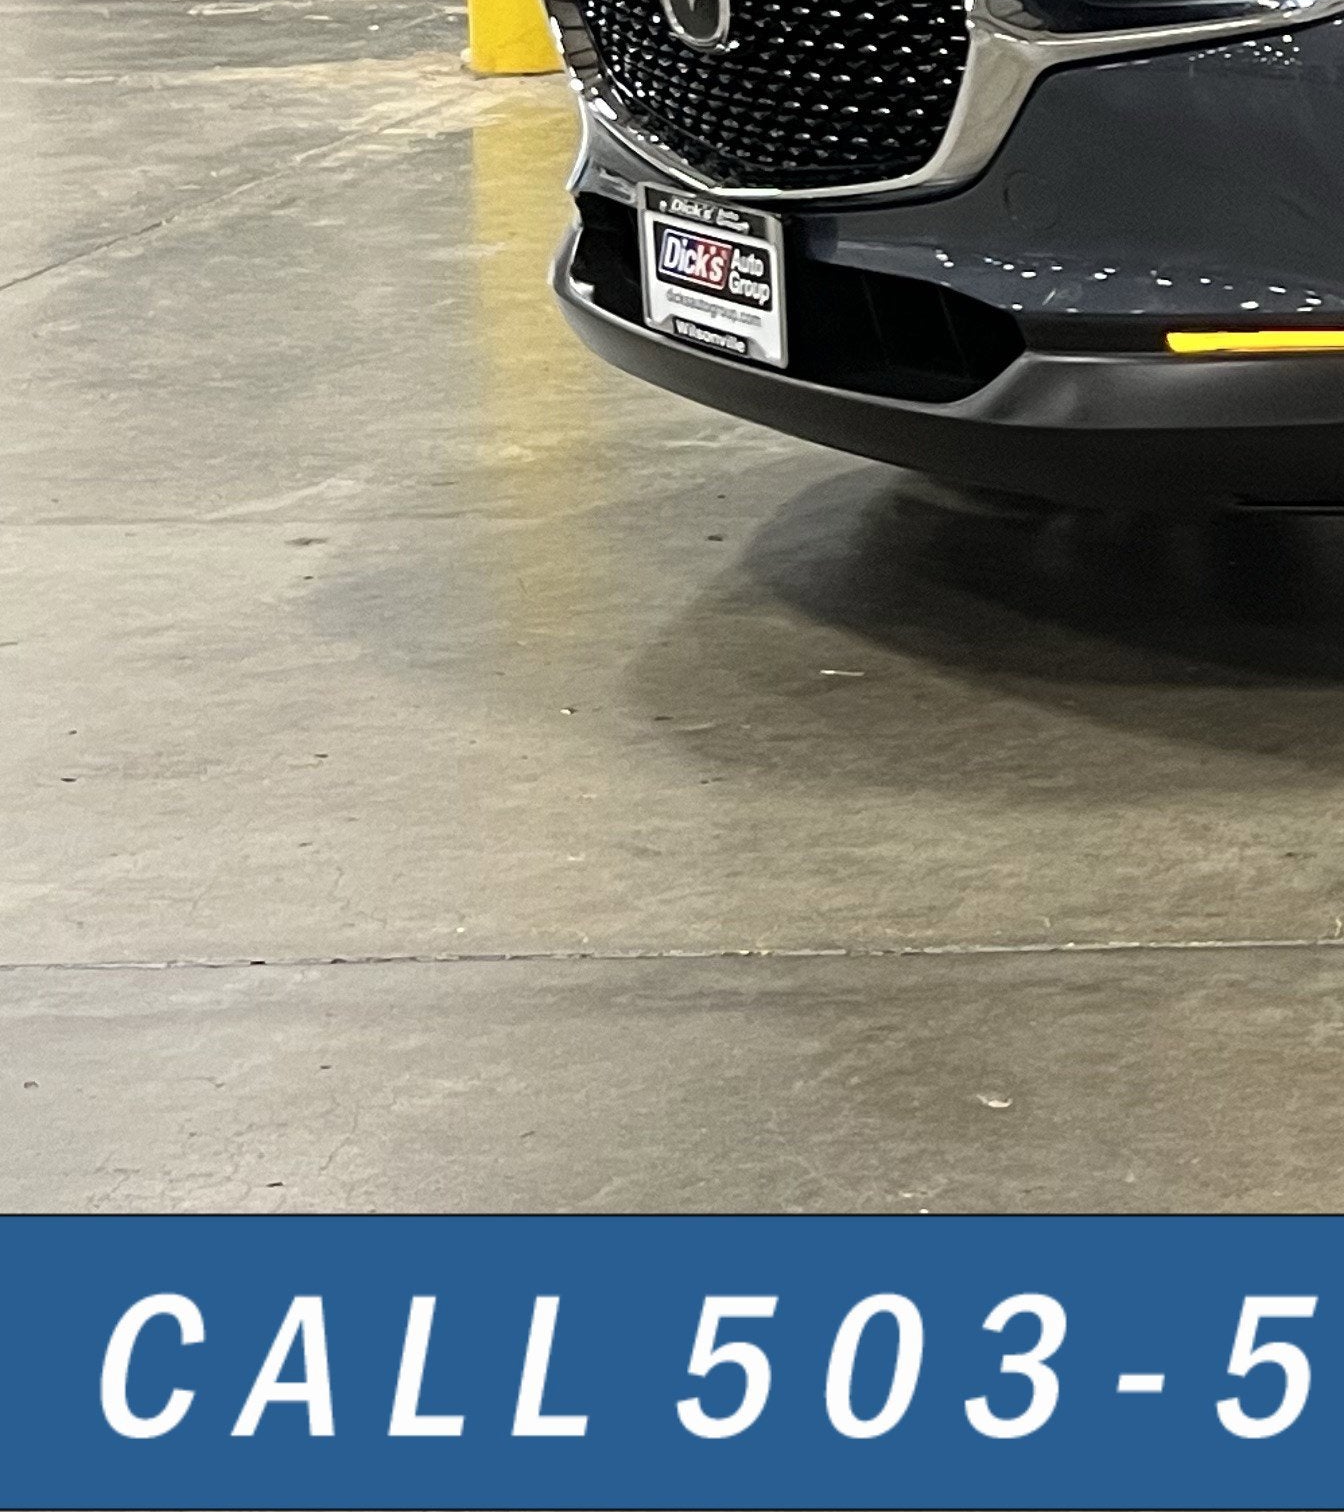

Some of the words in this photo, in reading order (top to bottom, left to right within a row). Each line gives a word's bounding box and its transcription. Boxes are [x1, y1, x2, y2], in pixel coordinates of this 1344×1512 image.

[663, 235, 725, 282] Dick's
[730, 248, 764, 277] Auto
[728, 270, 770, 306] Group
[674, 318, 746, 353] Wilsonville
